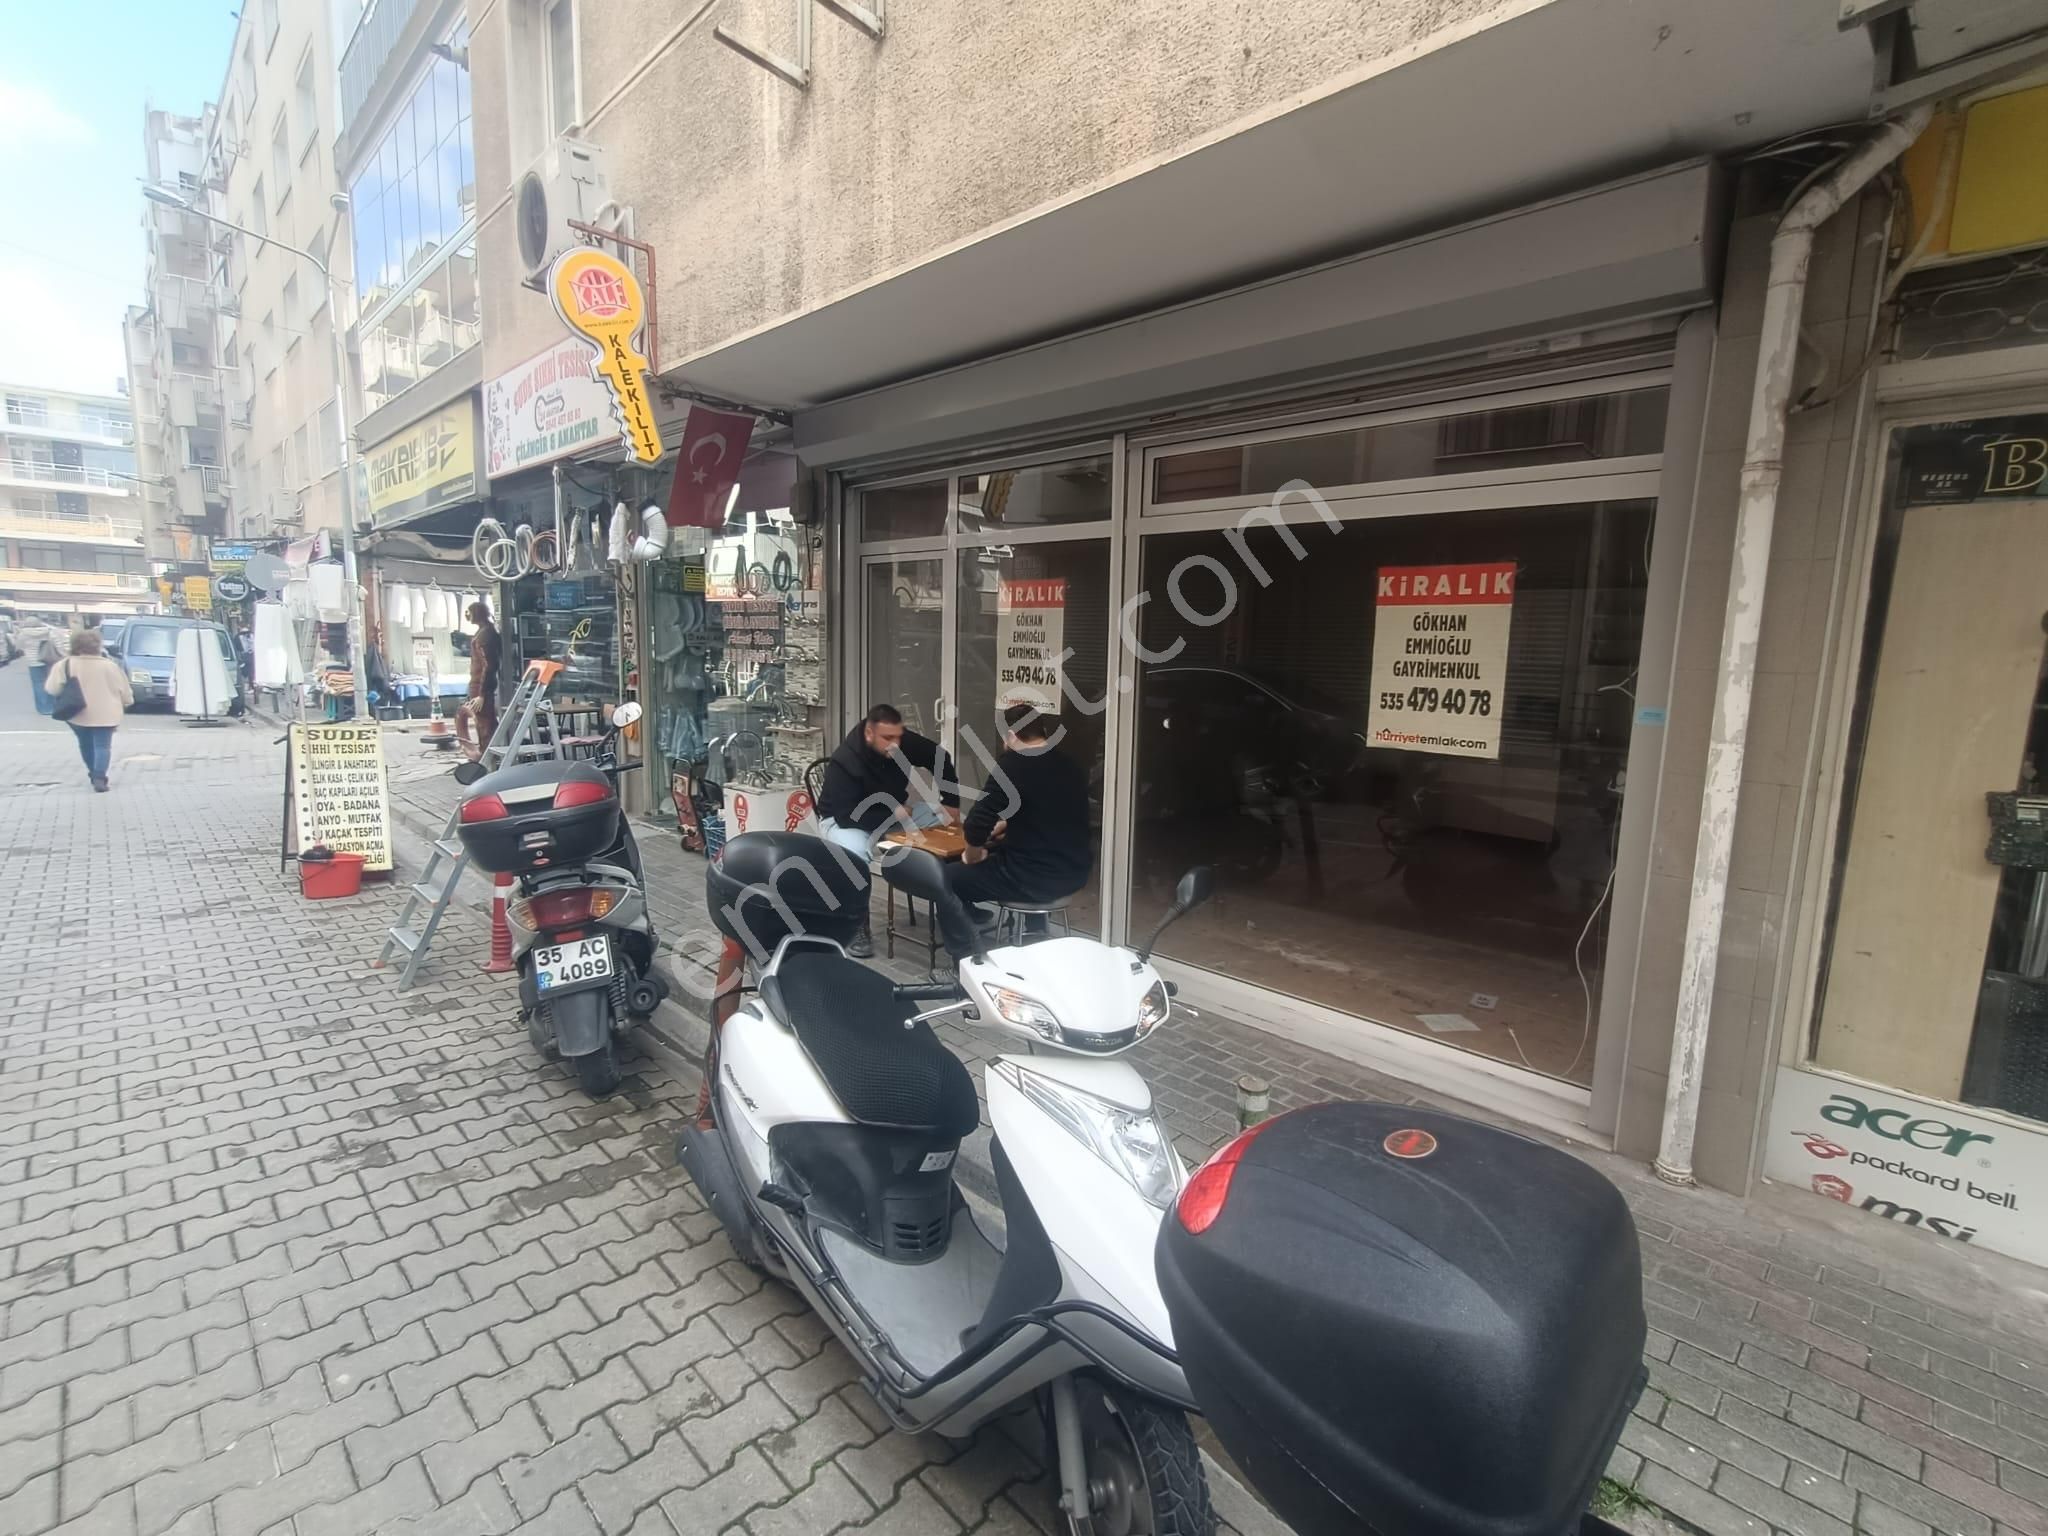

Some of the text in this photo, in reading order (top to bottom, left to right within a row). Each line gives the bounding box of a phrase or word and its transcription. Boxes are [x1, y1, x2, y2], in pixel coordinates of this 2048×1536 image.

[573, 281, 628, 311] KALE
[1016, 612, 1043, 628] GÖKHAN
[1413, 612, 1467, 632] GÖKHAN
[1013, 629, 1046, 643] EMMİOĞLU
[1405, 635, 1471, 656] EMMİOĞLU
[1001, 665, 1056, 685] 535 479 40 78
[1393, 658, 1480, 680] GAYRİMENKUL
[1380, 686, 1491, 716] 535 479 40 78
[308, 729, 371, 741] SUDE
[334, 743, 376, 754] TESİSAT
[328, 773, 343, 783] KASA
[365, 773, 379, 783] KAPI
[313, 786, 380, 800] RAÇ KAPILARI AÇILIR
[311, 801, 335, 812] OYA
[343, 800, 381, 811] BADANA
[312, 815, 341, 826] ANYO
[348, 813, 382, 824] MUTFAK
[325, 827, 352, 841] KAÇAK
[354, 824, 383, 838] TESPİTİ
[537, 939, 605, 967] 35 AC
[560, 959, 607, 982] 4089
[1820, 1094, 1995, 1157] acer
[1850, 1150, 1960, 1191] packard
